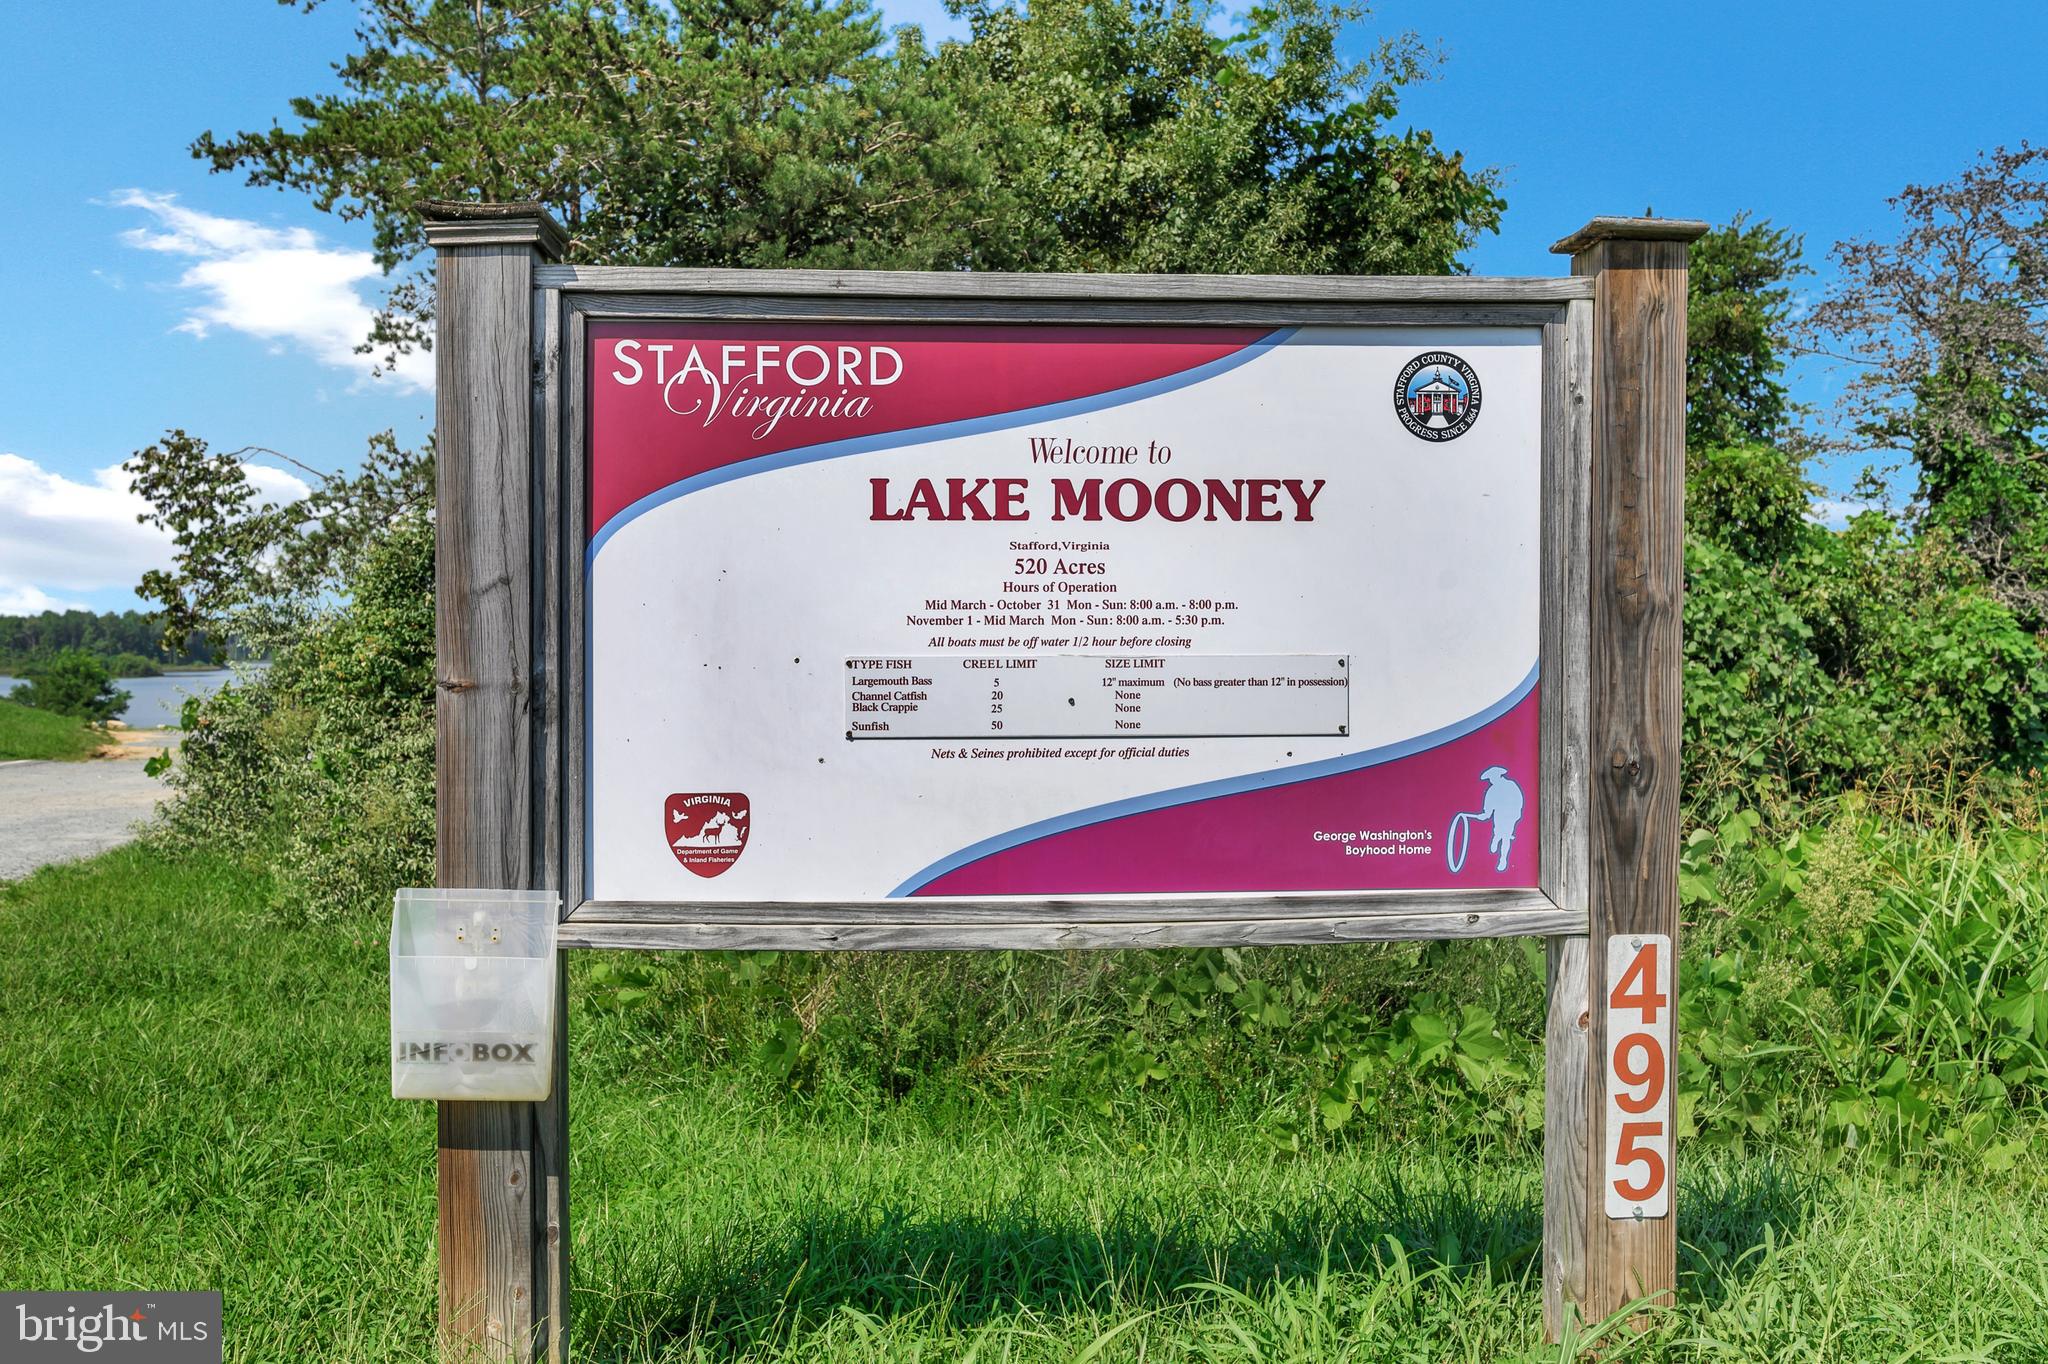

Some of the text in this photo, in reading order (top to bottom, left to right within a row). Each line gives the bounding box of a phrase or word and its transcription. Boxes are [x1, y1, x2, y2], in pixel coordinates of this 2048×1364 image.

[612, 339, 903, 386] STAFFORD
[1396, 354, 1480, 406] STAFFORD COUNTY VIRGINIA
[663, 366, 873, 440] Virginia
[1398, 407, 1479, 440] PROGRESS SINCE 1664
[1028, 437, 1172, 465] Welcome to
[869, 477, 1327, 523] LAKE MOONEY
[1014, 557, 1106, 575] 520 Acres
[1003, 581, 1117, 595] Hours of Operation
[925, 599, 948, 611] Mid
[950, 599, 987, 611] March
[996, 599, 1042, 611] October
[1047, 599, 1060, 611] 31
[1066, 599, 1092, 611] Mon
[1102, 599, 1127, 611] Sun:
[1129, 599, 1153, 611] 8:00
[1155, 601, 1179, 611] a.m.
[1188, 599, 1212, 611] 8:00
[1214, 601, 1239, 613] p.m.
[906, 615, 964, 626] November
[967, 615, 973, 626] 1
[984, 615, 1006, 626] Mid
[1009, 614, 1045, 626] March
[1051, 614, 1077, 626] Mon
[1086, 614, 1113, 626] Sun:
[1116, 614, 1140, 626] 8:00
[1141, 617, 1165, 626] a.m.
[1175, 614, 1199, 626] 5:30
[1200, 617, 1225, 628] p.m.
[927, 635, 1192, 650] All boats must be off water 1/2 hour before closing
[852, 659, 912, 670] TYPE FISH
[962, 659, 1038, 669] CREEL LIMIT
[1104, 658, 1166, 669] SIZE LIMIT
[851, 675, 933, 688] Largemouth Bass
[993, 677, 1000, 688] 5
[1118, 677, 1165, 687] maximum
[1173, 677, 1192, 689] (No
[1192, 677, 1213, 687] bass
[1213, 678, 1247, 689] greater
[1247, 676, 1269, 687] than
[1286, 676, 1296, 687] in
[1297, 676, 1348, 689] possession)
[851, 690, 928, 701] Channel Catfish
[991, 690, 1004, 701] 20
[1114, 690, 1141, 700] None
[851, 702, 919, 715] Black Crappie
[991, 703, 1003, 714] 25
[1114, 703, 1142, 713] None
[851, 720, 890, 732] Sunfish
[991, 720, 1004, 731] 50
[1114, 719, 1141, 730] None
[930, 746, 1190, 761] Nets & Seines prohibited except for official duties
[683, 795, 732, 808] VIRGINIA
[1313, 829, 1433, 843] George Washington's
[676, 848, 712, 857] Department
[1345, 844, 1432, 857] Boyhood Home
[688, 856, 708, 864] Inland
[708, 856, 735, 864] Fisheries
[472, 1042, 538, 1063] BOX
